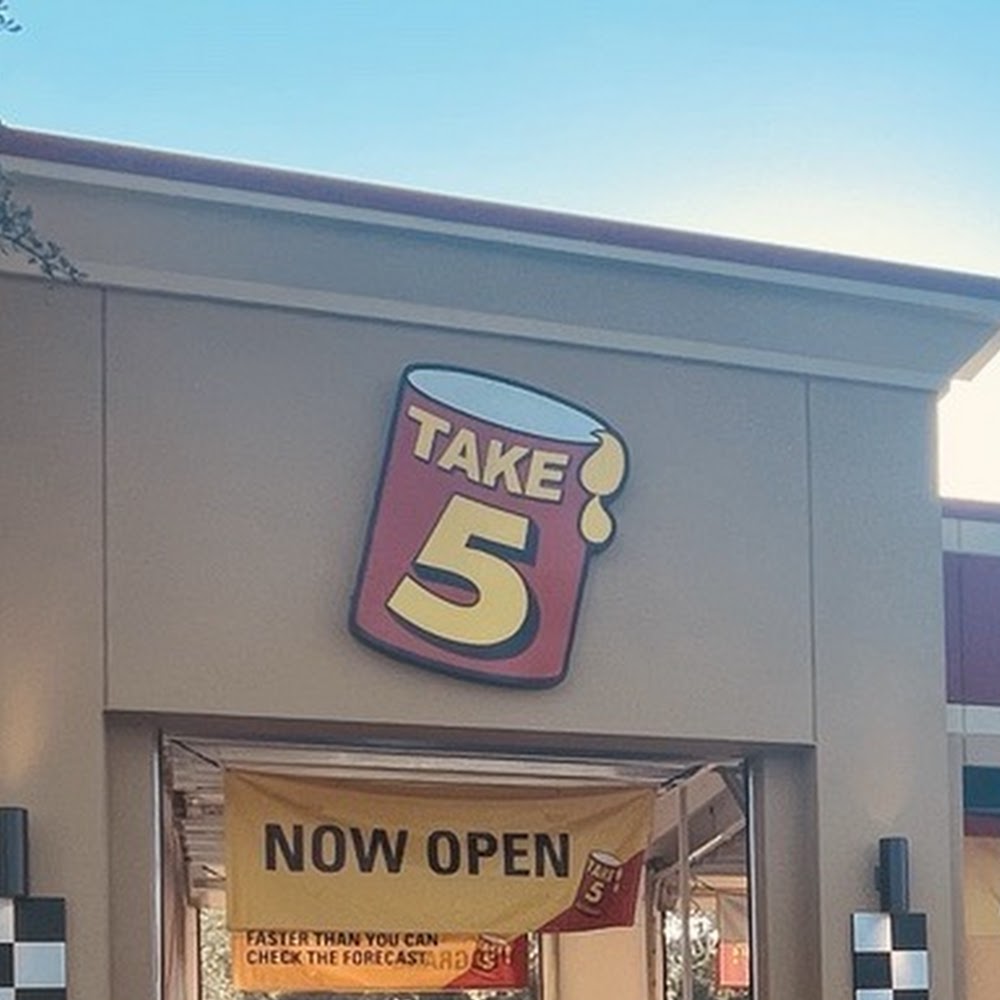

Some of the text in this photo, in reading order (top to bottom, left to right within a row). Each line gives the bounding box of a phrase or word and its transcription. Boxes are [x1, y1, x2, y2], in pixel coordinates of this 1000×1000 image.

[407, 405, 569, 502] TAKE
[386, 494, 532, 648] 5
[264, 824, 570, 878] NOW OPEN
[585, 881, 605, 903] 5
[247, 932, 438, 946] FASTER THAN YOU CAN
[247, 950, 426, 966] CHECK THE FORECAST
